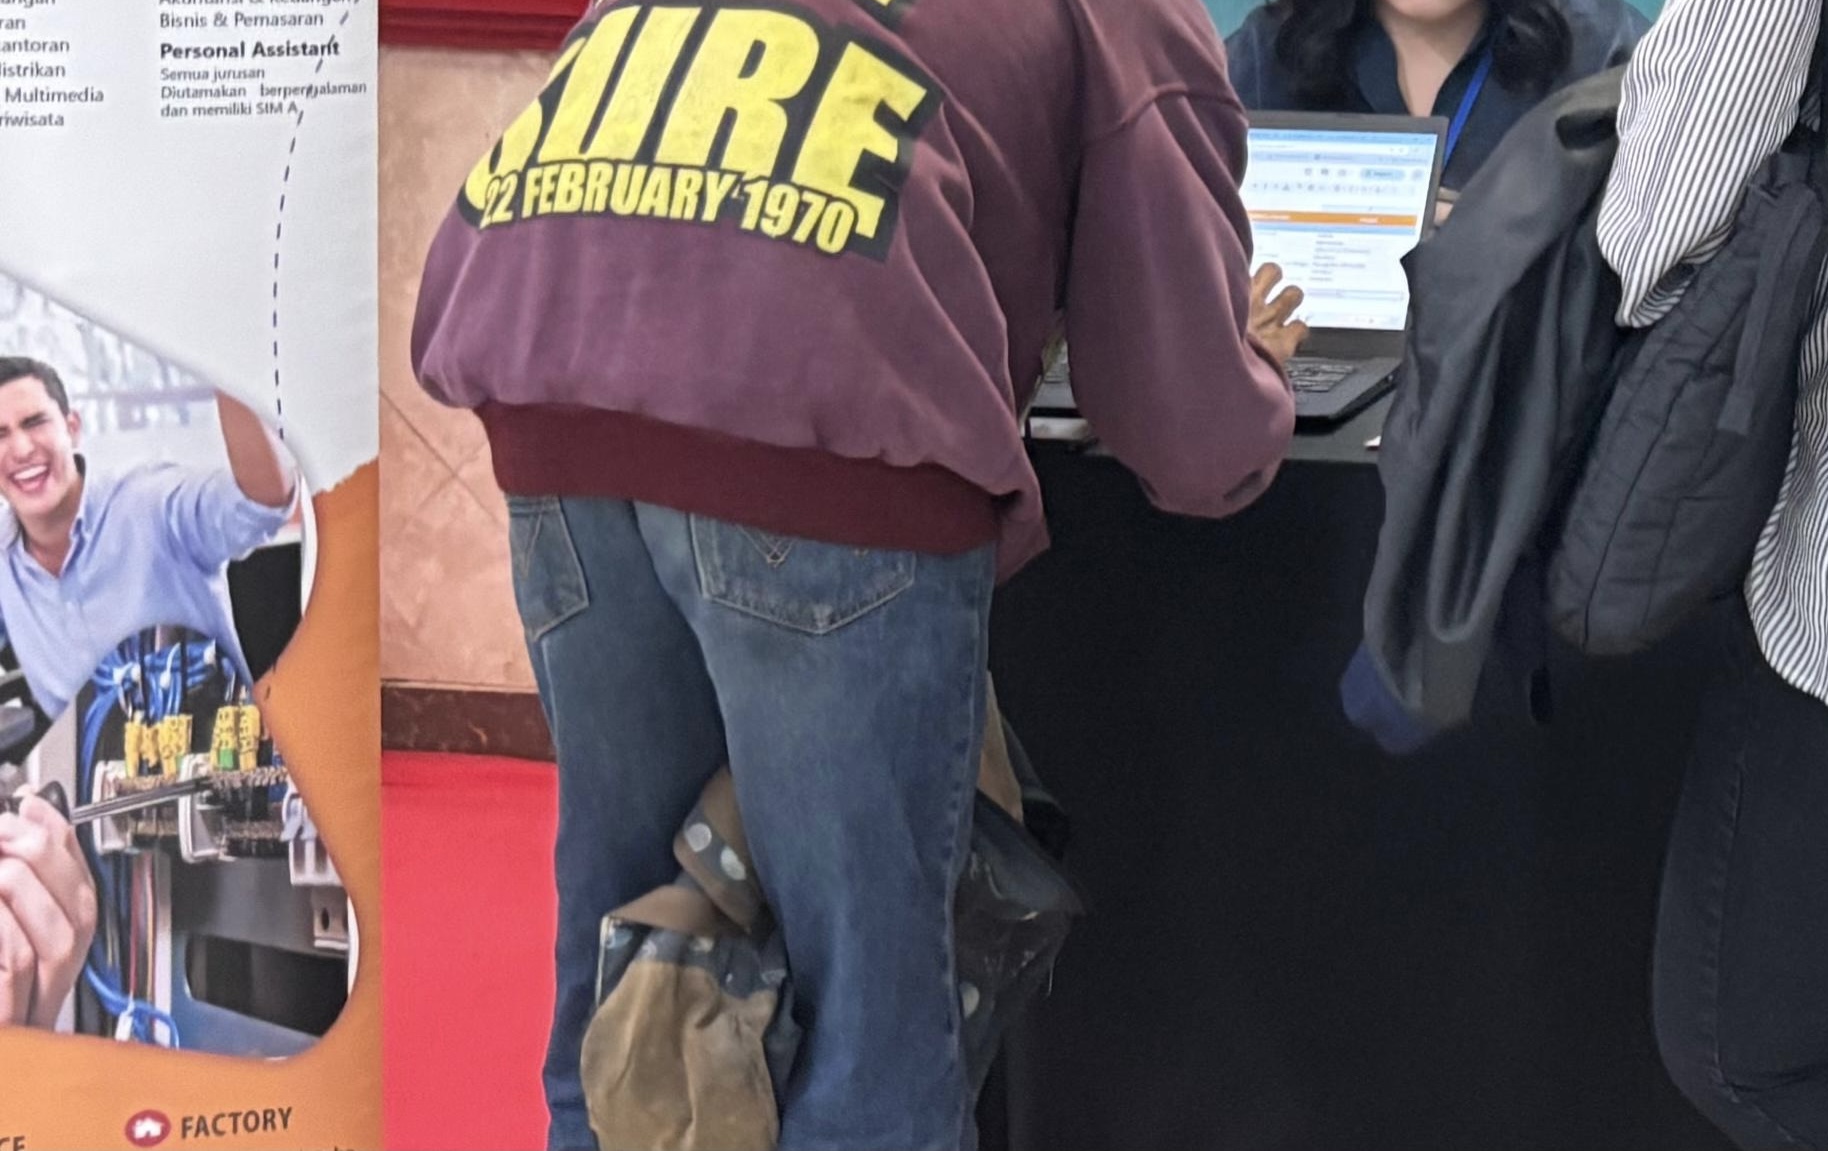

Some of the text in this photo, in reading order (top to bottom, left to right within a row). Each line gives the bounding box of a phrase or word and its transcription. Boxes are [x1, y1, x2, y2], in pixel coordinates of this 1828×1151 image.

[160, 12, 324, 28] Bisnis & Pemasaran
[0, 38, 70, 53] antoran
[160, 39, 340, 59] Personal Assistant
[160, 67, 265, 83] Semua jurusan
[5, 86, 104, 103] Multimedia
[161, 81, 368, 100] Diutamakan berpengalaman
[160, 103, 188, 117] dan
[193, 101, 252, 116] memiliki
[256, 101, 284, 115] SIM
[479, 162, 855, 255] 22 FEBRUARY 1970
[181, 1107, 293, 1139] FACTORY
